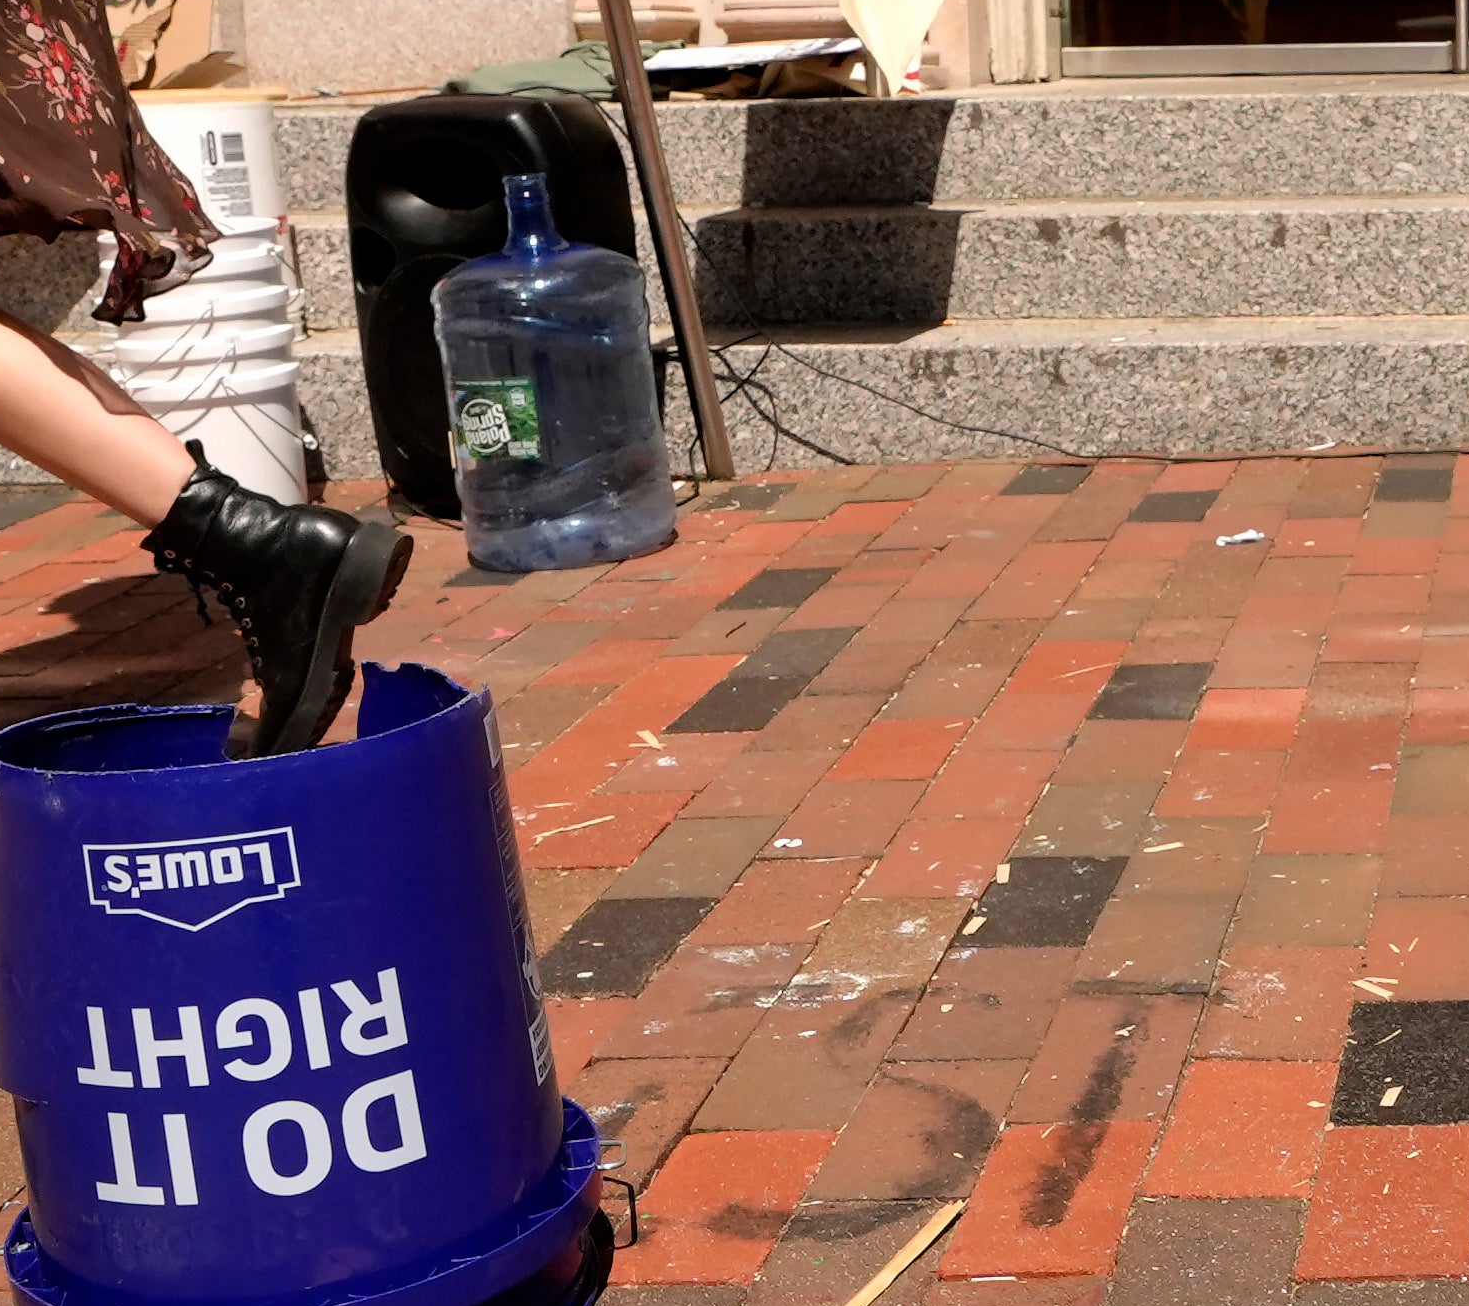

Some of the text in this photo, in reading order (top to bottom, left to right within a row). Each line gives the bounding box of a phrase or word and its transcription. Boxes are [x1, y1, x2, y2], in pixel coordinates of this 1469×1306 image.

[460, 402, 512, 447] Poland Spring
[105, 843, 278, 897] LOWE'S
[77, 967, 409, 1088] RIGHT
[96, 1069, 428, 1207] DO IT
